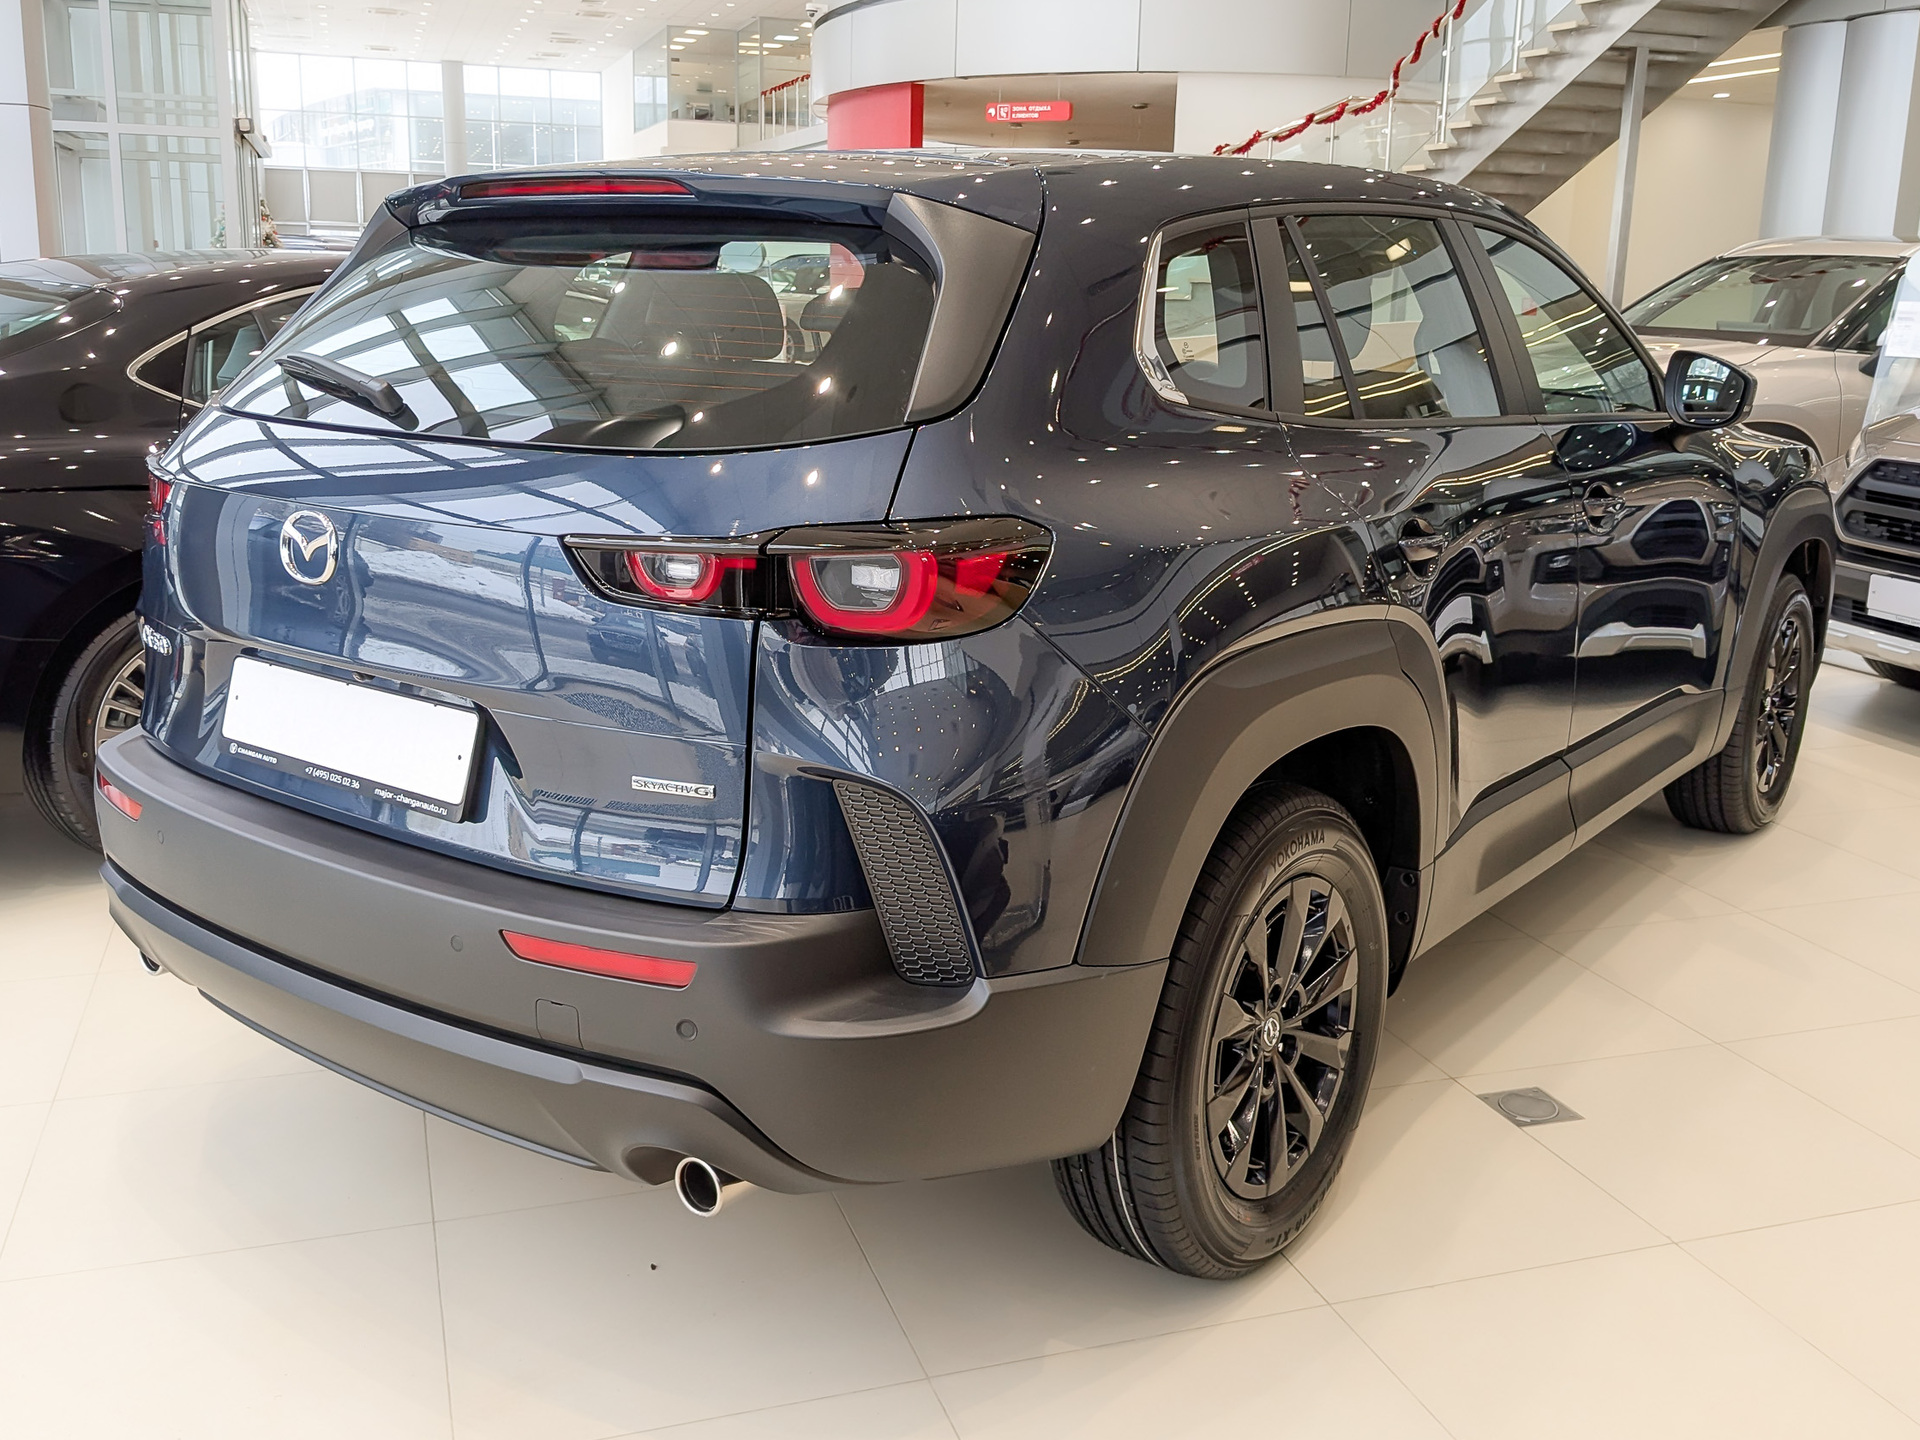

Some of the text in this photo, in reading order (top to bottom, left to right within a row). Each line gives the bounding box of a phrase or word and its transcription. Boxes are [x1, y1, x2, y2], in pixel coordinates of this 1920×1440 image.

[237, 747, 277, 764] CHANGAN AUTO
[305, 766, 360, 789] +7 (495) 025 02 36
[374, 787, 448, 816] major-changanauto.ru
[1270, 829, 1325, 872] YOKOHAMA
